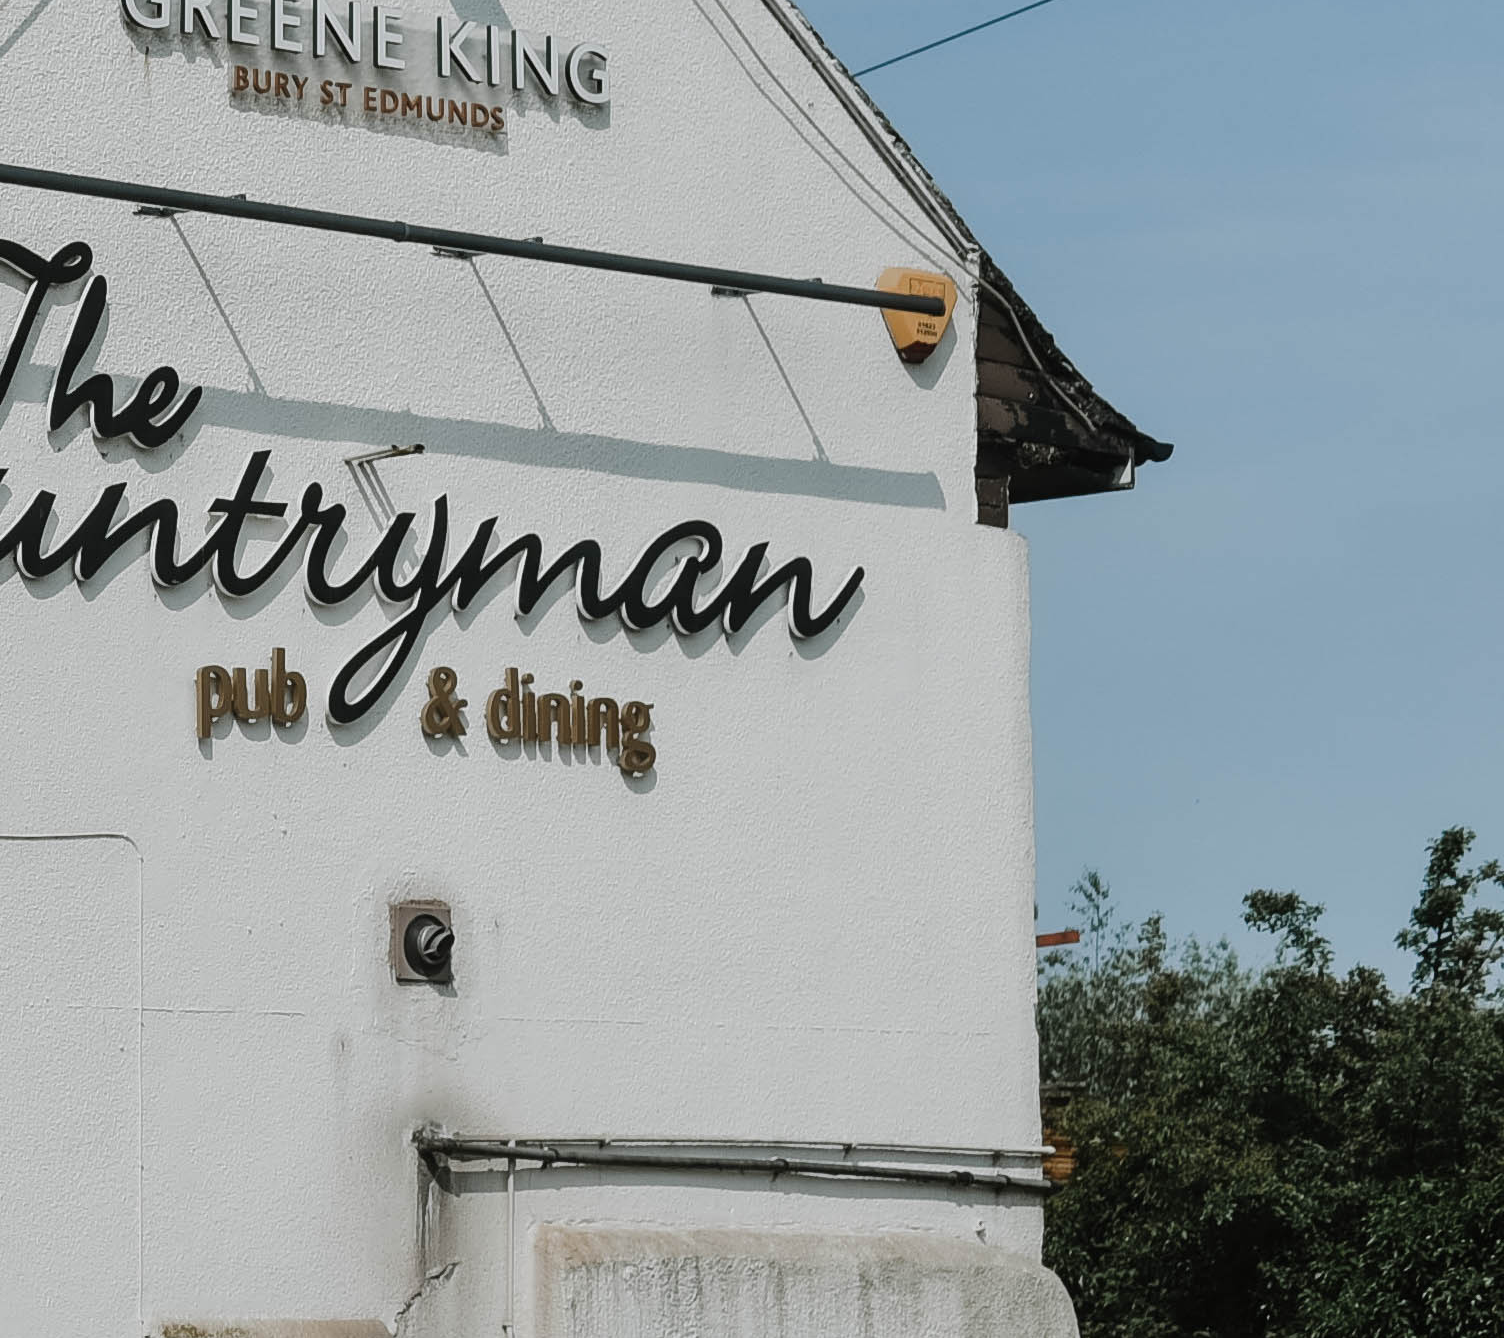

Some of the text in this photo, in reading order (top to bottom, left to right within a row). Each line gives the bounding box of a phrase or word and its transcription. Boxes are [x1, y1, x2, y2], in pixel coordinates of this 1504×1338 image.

[233, 66, 506, 131] BURY ST EDMUNDS
[437, 16, 611, 105] KING
[196, 648, 657, 777] pub & dining
